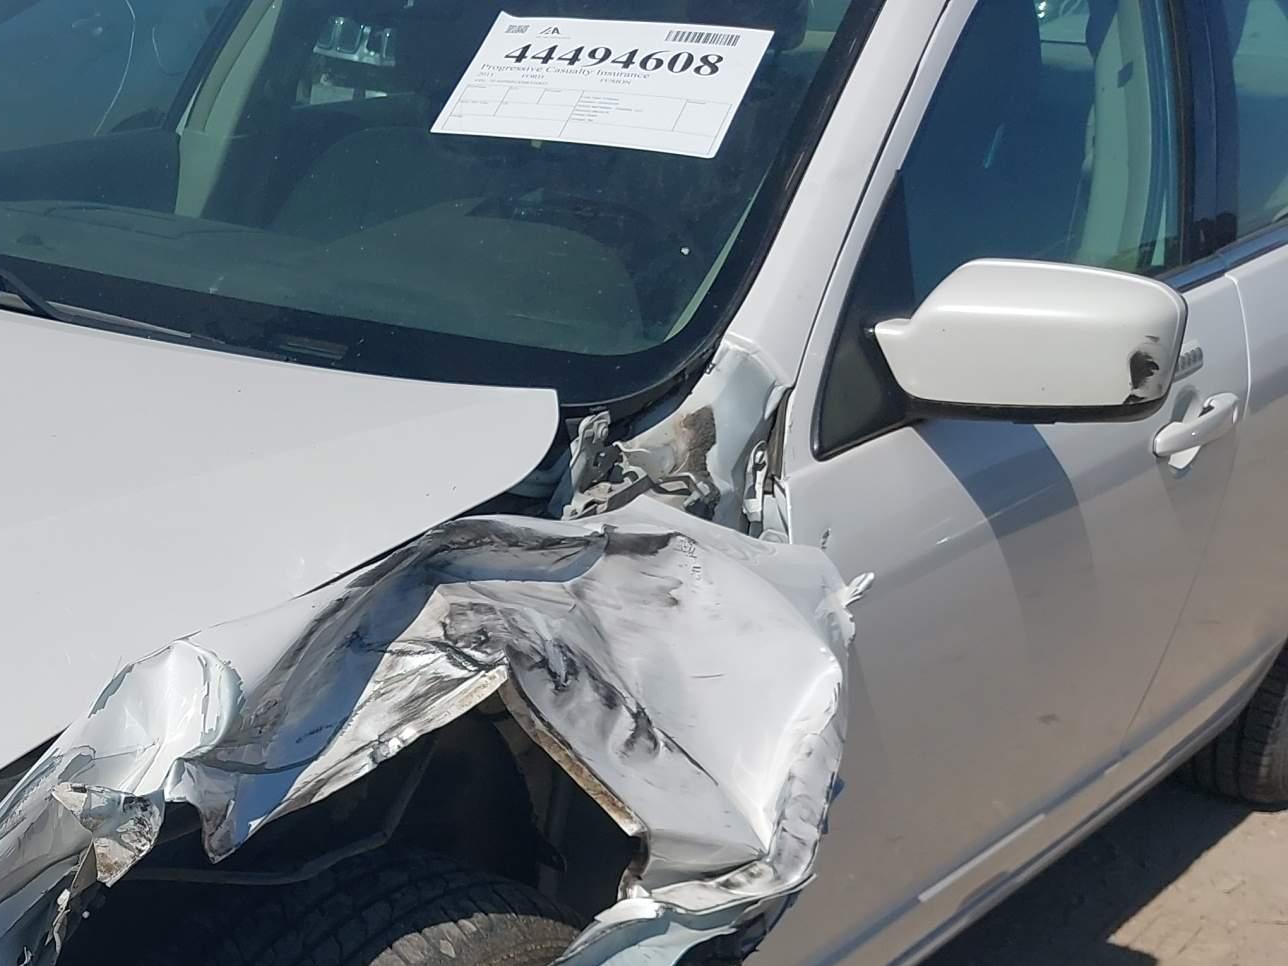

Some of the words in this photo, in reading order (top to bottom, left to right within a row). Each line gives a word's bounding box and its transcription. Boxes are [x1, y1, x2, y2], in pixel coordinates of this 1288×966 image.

[481, 63, 544, 74] Progressive
[546, 66, 595, 76] Casualty
[596, 69, 650, 79] Insurance
[503, 43, 724, 76] 44494608
